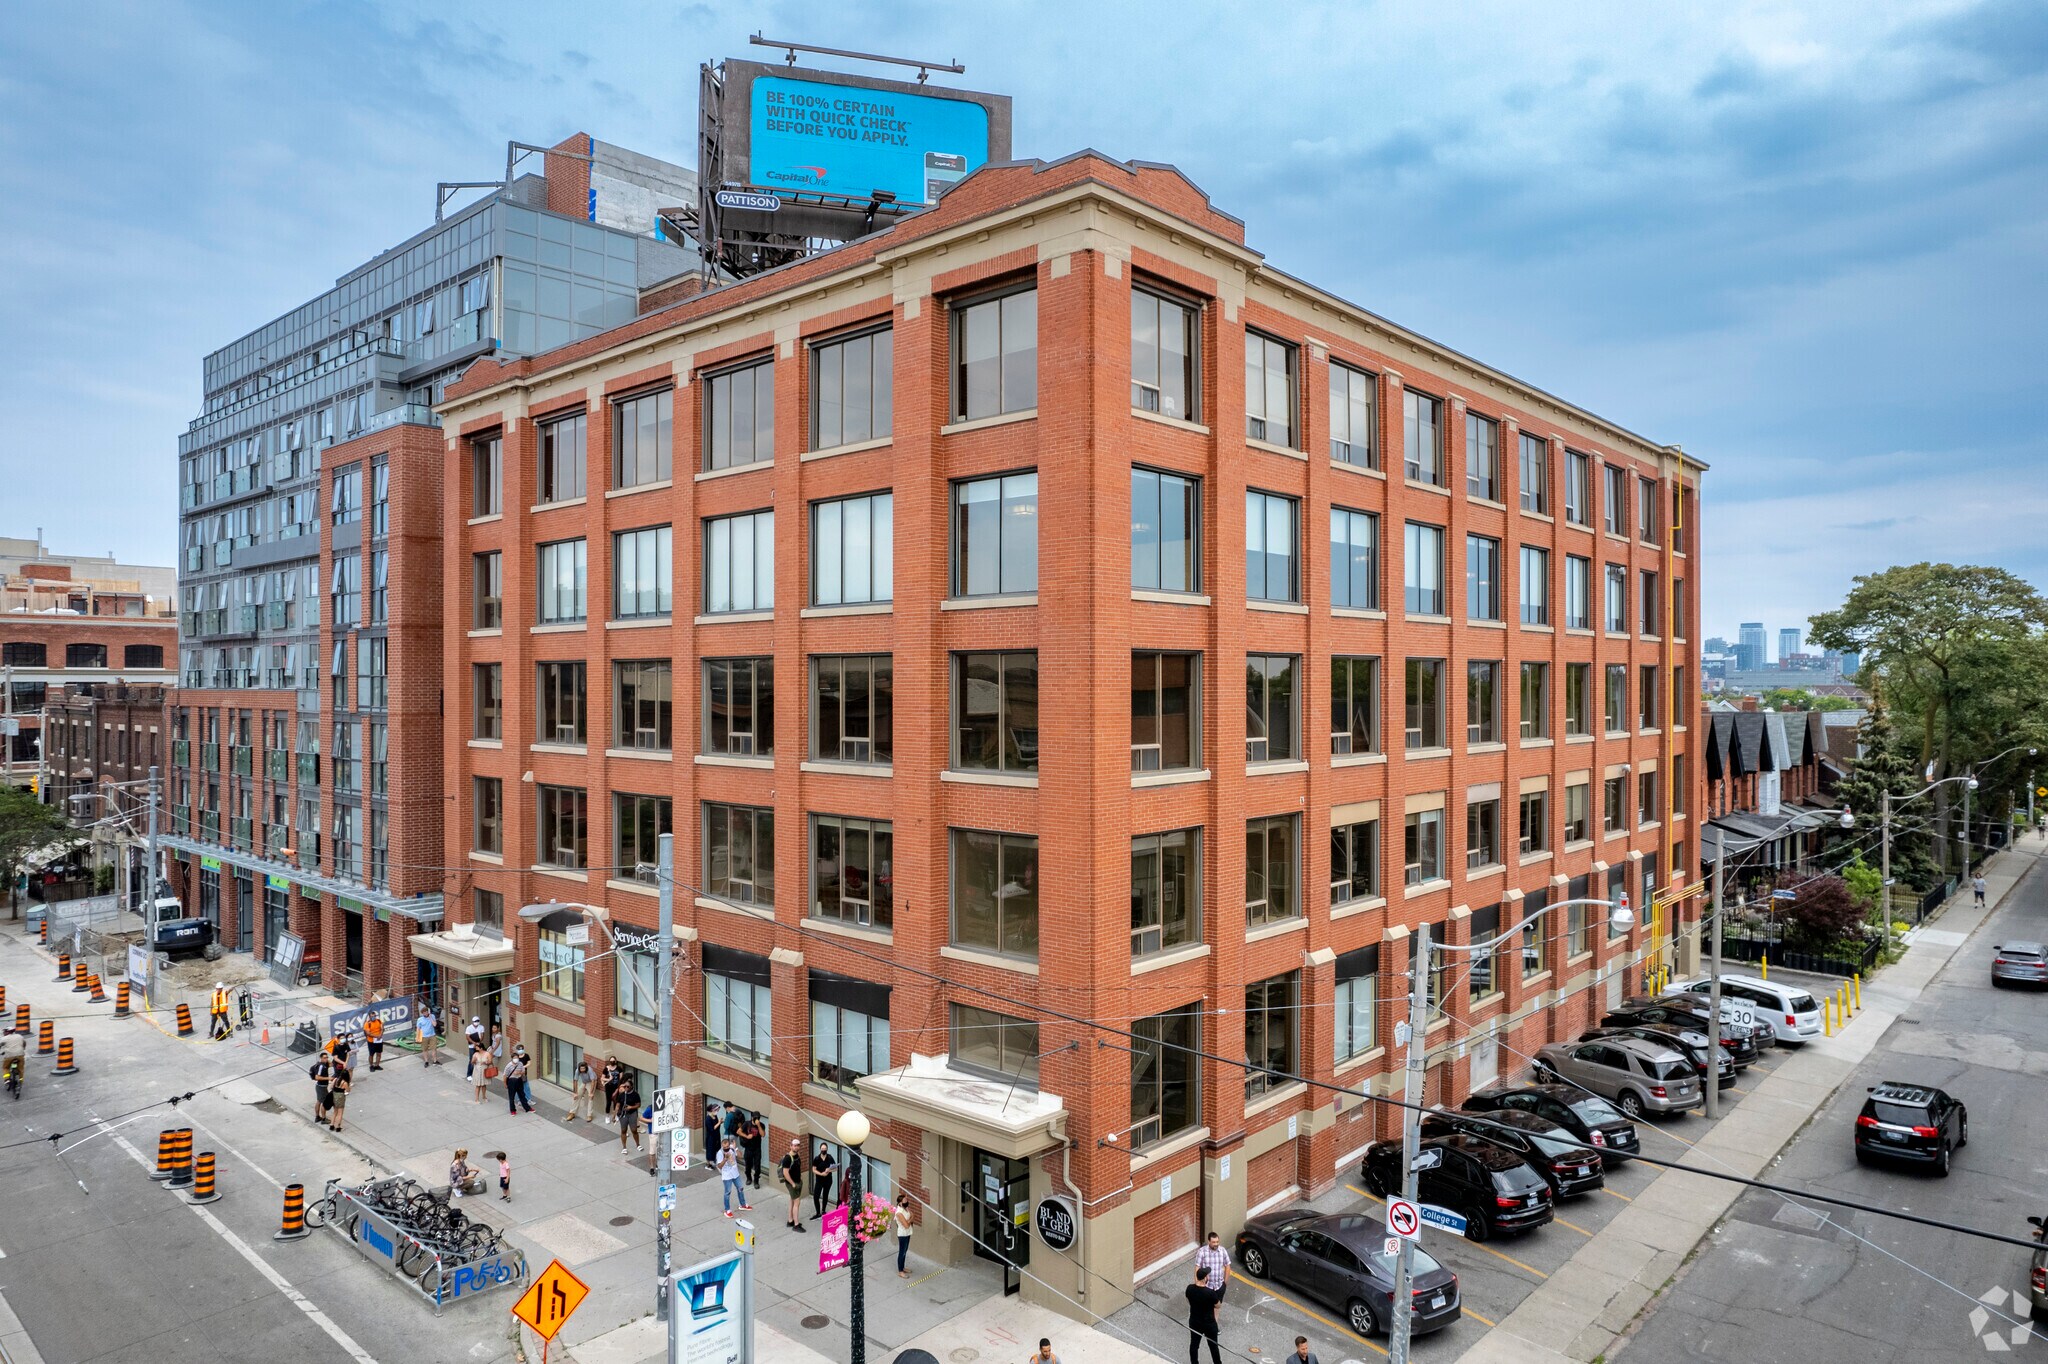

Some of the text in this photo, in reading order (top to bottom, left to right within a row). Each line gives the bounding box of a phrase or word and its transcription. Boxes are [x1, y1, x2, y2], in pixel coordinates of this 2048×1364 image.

[766, 91, 895, 117] BE 100% CERTAIN
[766, 105, 805, 120] WITH
[810, 110, 855, 127] QUICK
[766, 119, 909, 147] BEFORE YOU APPLY.
[721, 194, 775, 208] PATTISON
[615, 926, 659, 949] Service Can
[1733, 1010, 1752, 1025] 30
[657, 1113, 679, 1127] BEGINS
[1421, 1208, 1450, 1224] College
[454, 1267, 475, 1297] P
[726, 1353, 738, 1364] Bell
